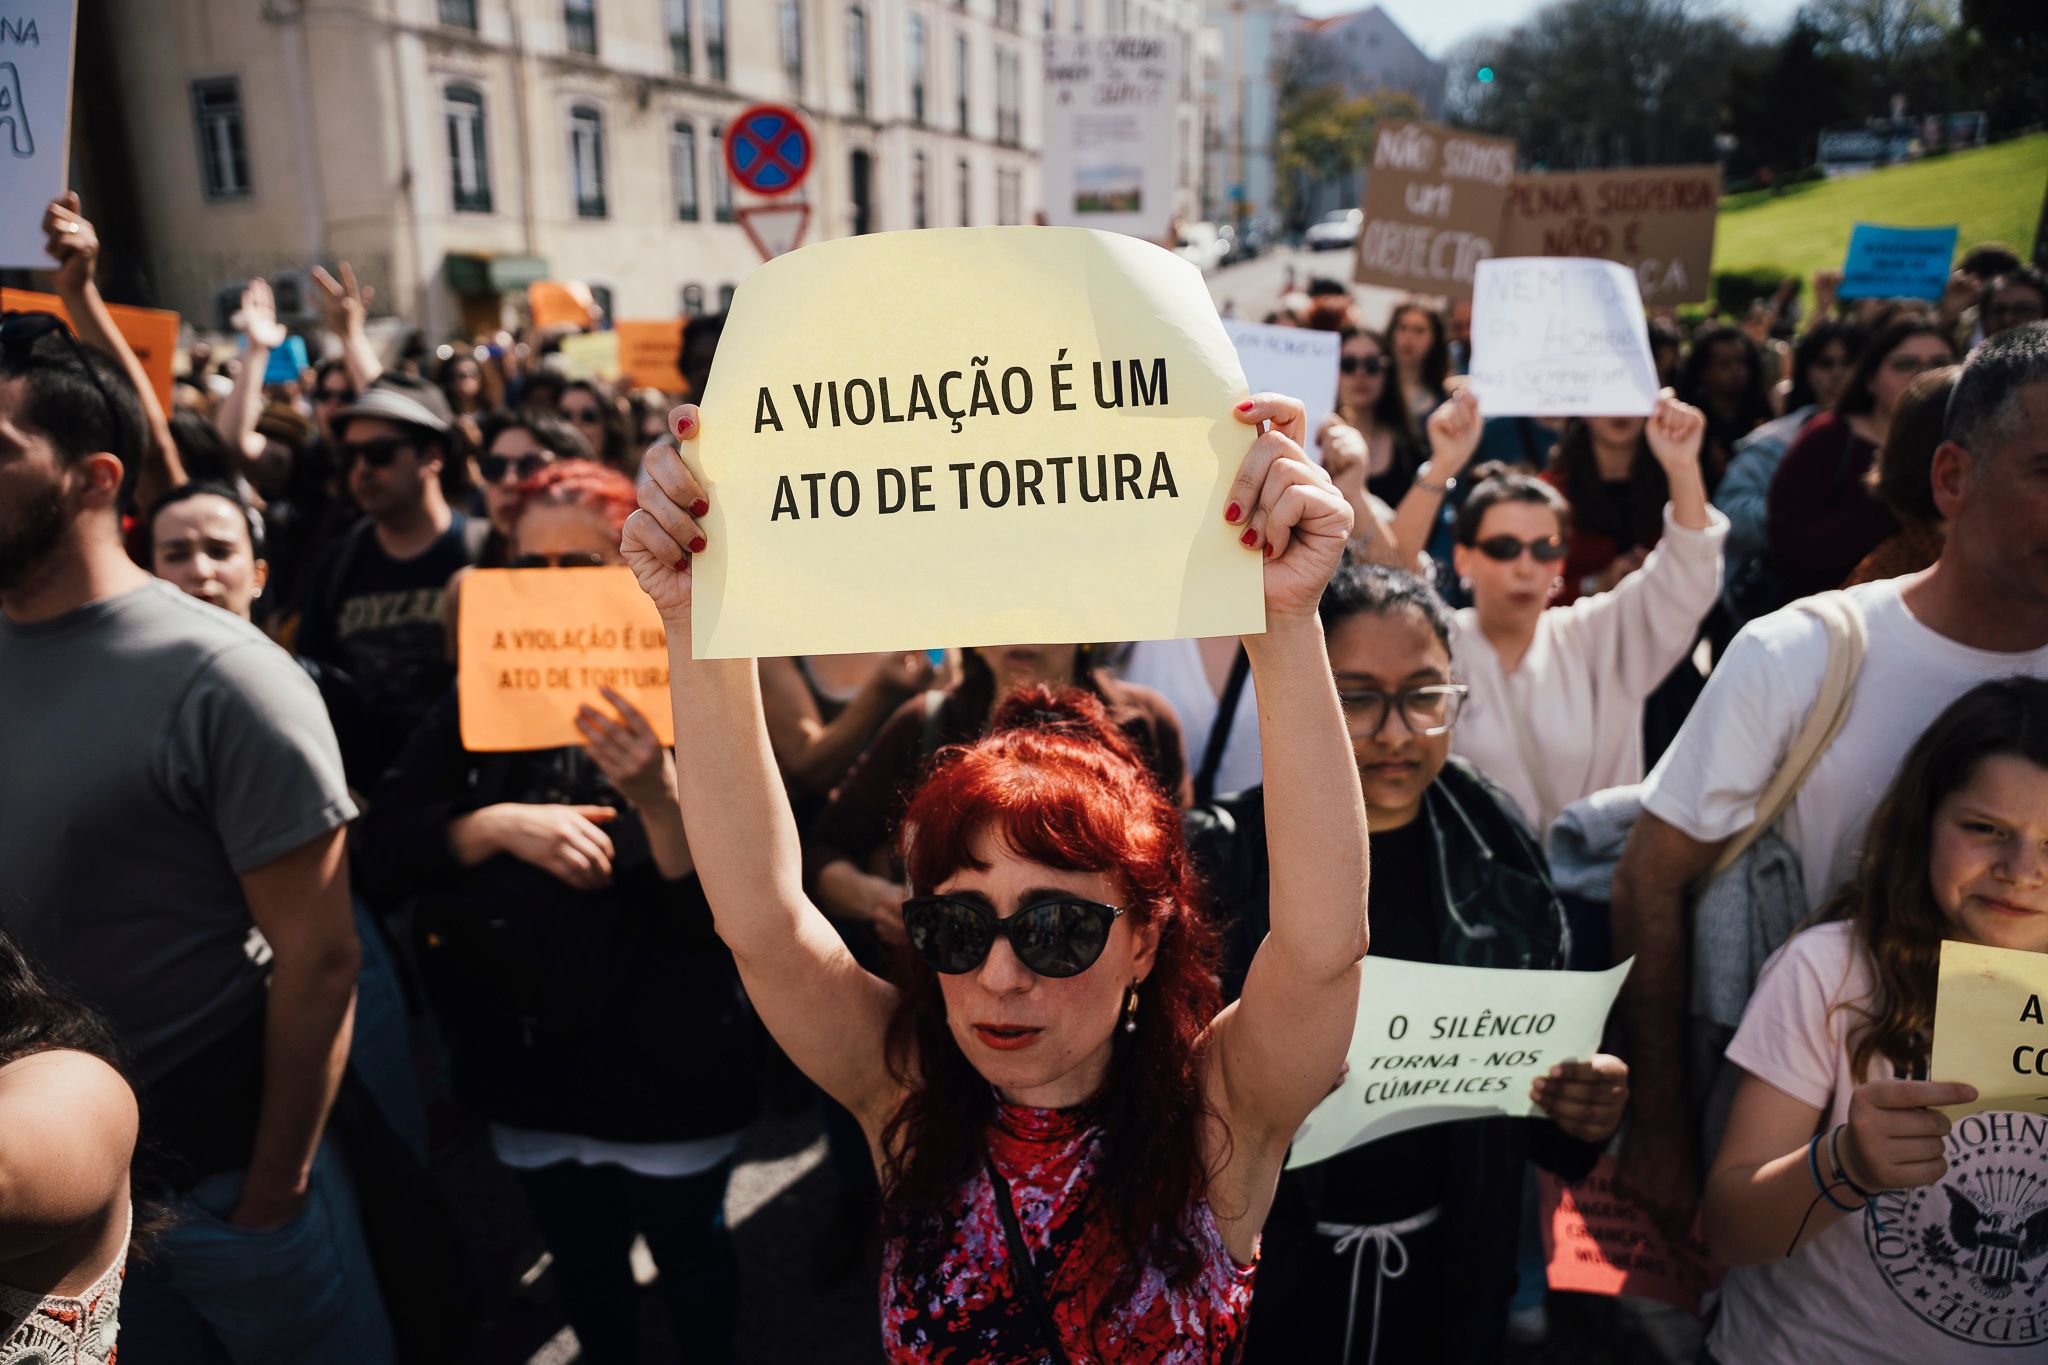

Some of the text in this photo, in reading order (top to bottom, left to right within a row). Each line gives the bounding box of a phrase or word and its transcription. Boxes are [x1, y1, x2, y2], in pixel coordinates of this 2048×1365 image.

[1595, 178, 1713, 215] SUSPENSA
[753, 349, 1170, 434] A VIOLAÇÃO É UM
[770, 451, 1180, 522] ATO DE TORTURA
[493, 630, 508, 649] A
[511, 623, 617, 655] VIOLAÇÃO
[622, 621, 635, 650] É
[499, 667, 542, 690] ATO
[547, 667, 571, 689] DE
[1388, 1008, 1556, 1040] O SILÊNCIO
[2019, 993, 2044, 1025] A
[1368, 1053, 1460, 1071] TORNA
[1484, 1049, 1544, 1067] NOS
[1364, 1076, 1511, 1104] CÚMPLICES
